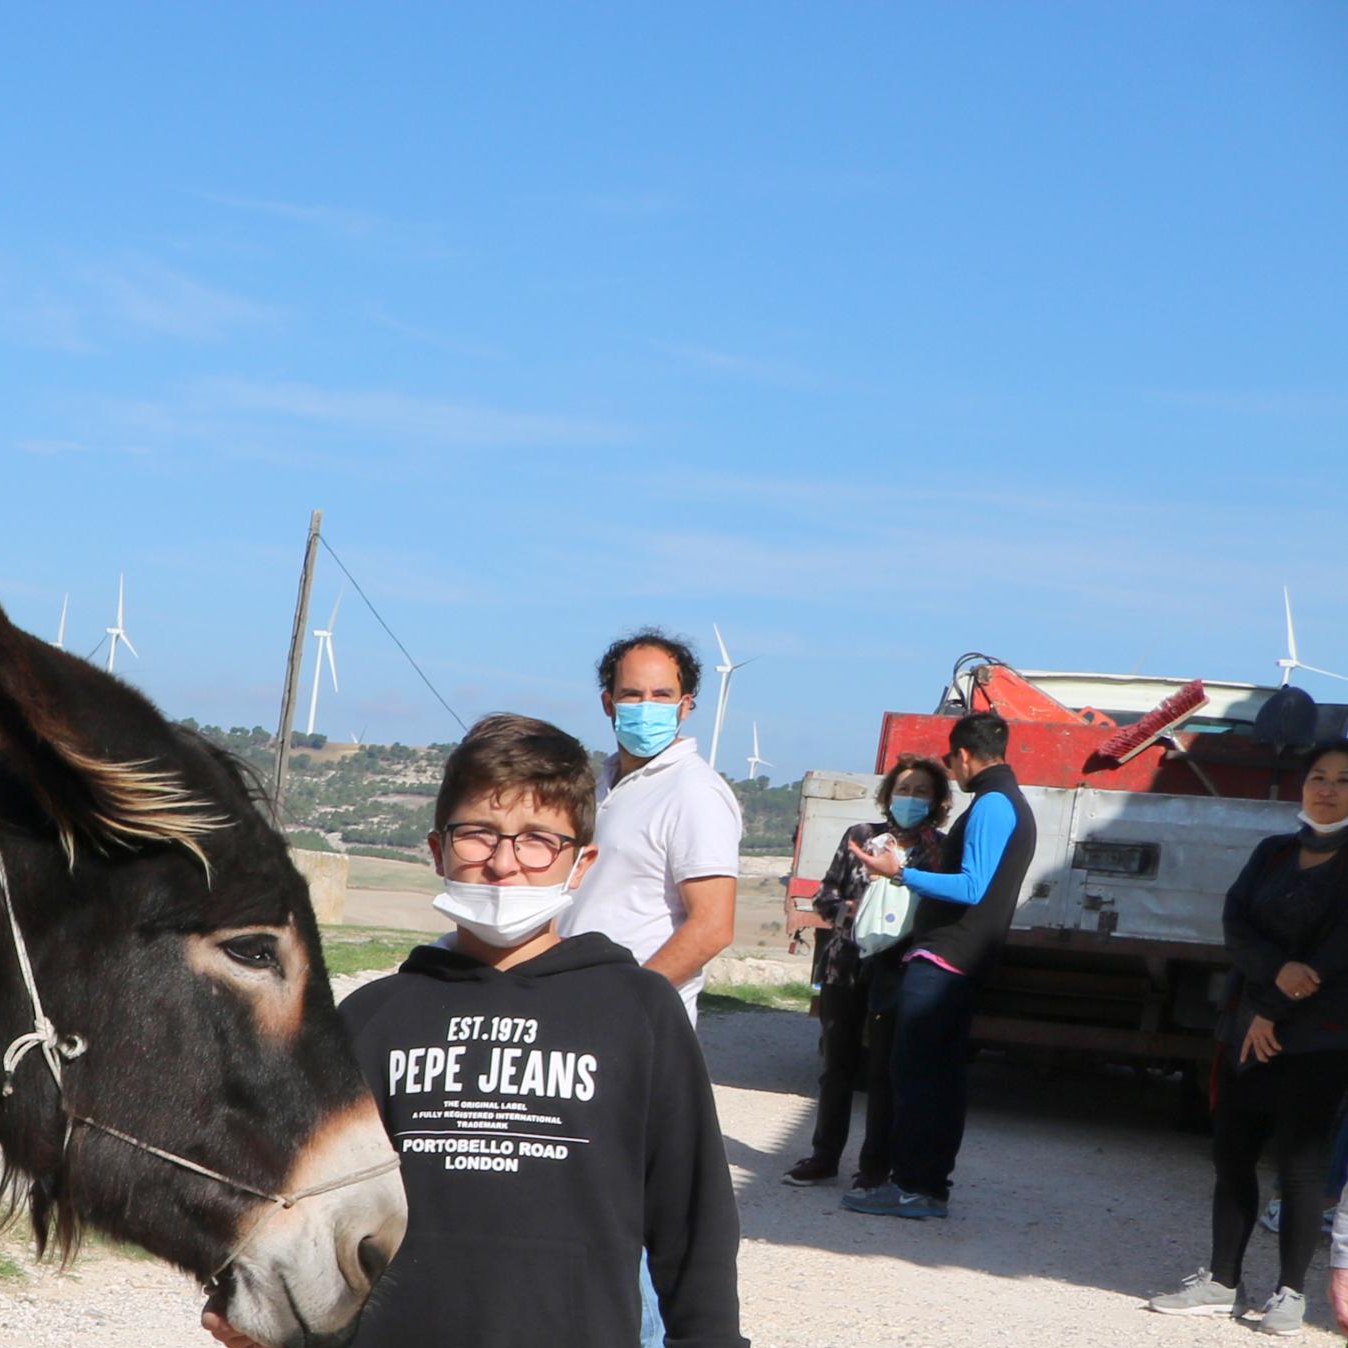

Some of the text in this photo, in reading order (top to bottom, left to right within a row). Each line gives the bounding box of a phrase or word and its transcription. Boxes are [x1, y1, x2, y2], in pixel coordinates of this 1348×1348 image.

[389, 1046, 598, 1102] PEPE JEANS
[443, 1100, 528, 1111] THE ORIGINAL LABEL
[419, 1111, 443, 1119] FULLY
[444, 1110, 494, 1119] REGISTERED
[495, 1112, 563, 1124] INTERNATIONAL
[457, 1120, 509, 1130] TRADEMARK
[402, 1138, 569, 1160] PORTOBELLO ROAD
[445, 1155, 519, 1173] LONDON
